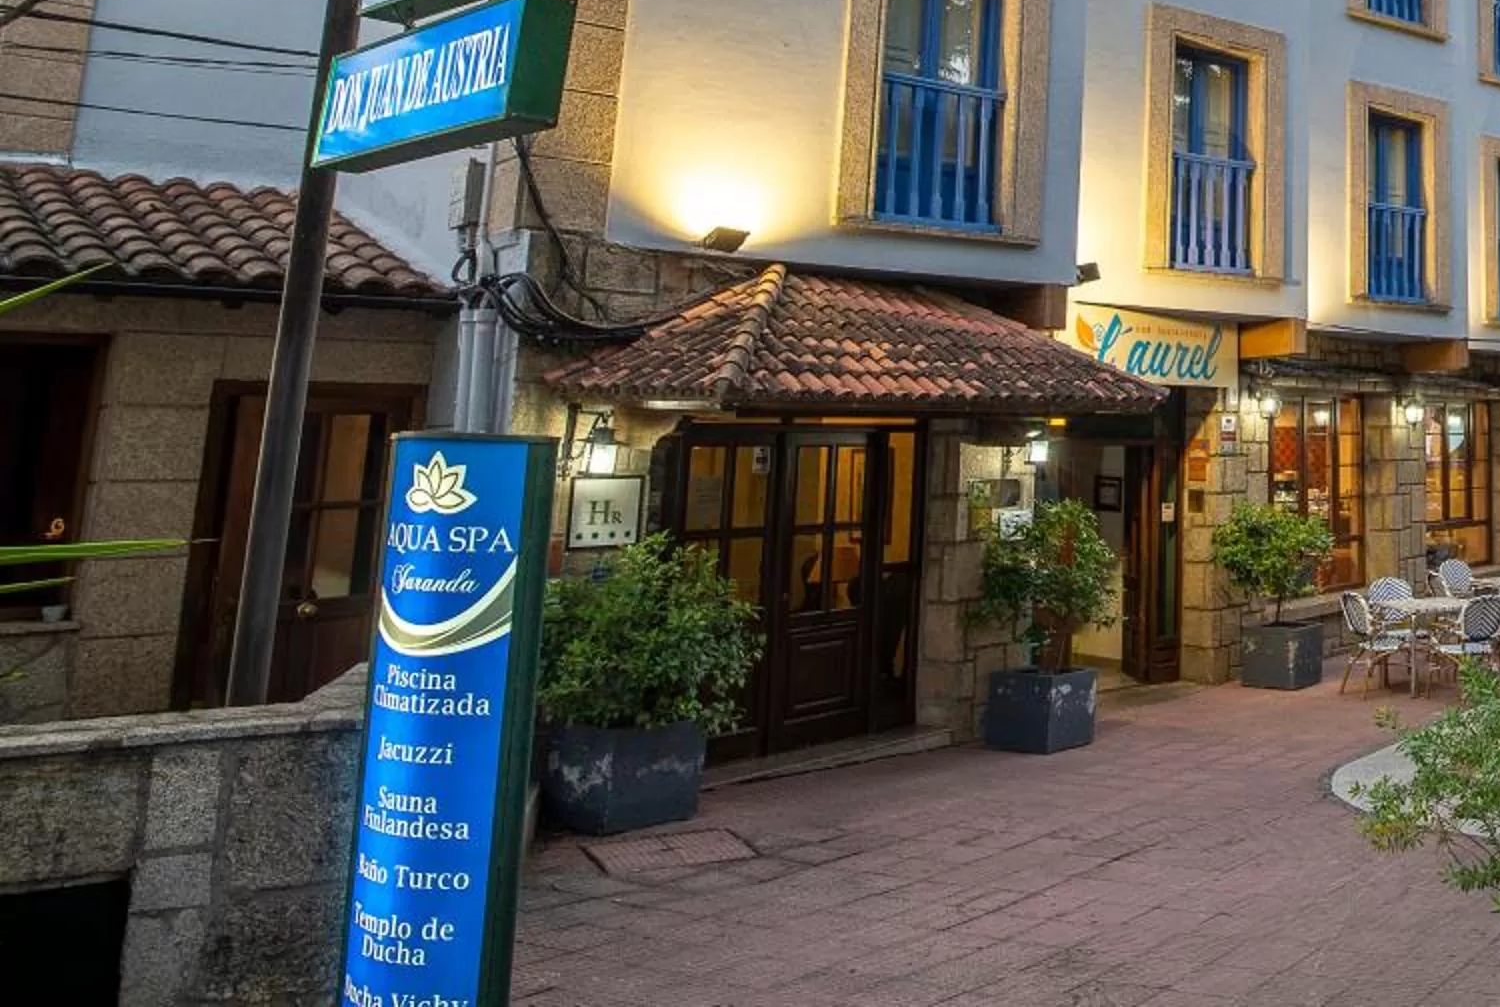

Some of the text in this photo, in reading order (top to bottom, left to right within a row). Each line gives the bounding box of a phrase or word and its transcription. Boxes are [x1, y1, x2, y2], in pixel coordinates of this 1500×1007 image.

[326, 22, 511, 134] DON JUAN DE AUSTRIA
[387, 522, 514, 553] AQUA SPA
[387, 664, 457, 691] Piscina
[374, 684, 491, 716] Climatizada
[377, 736, 453, 765] Jacuzzi
[378, 785, 438, 814] Sauna
[364, 805, 470, 841] Finlandesa
[359, 853, 470, 890] Baño Turco
[354, 901, 455, 941] Templo de
[361, 934, 427, 967] Ducha
